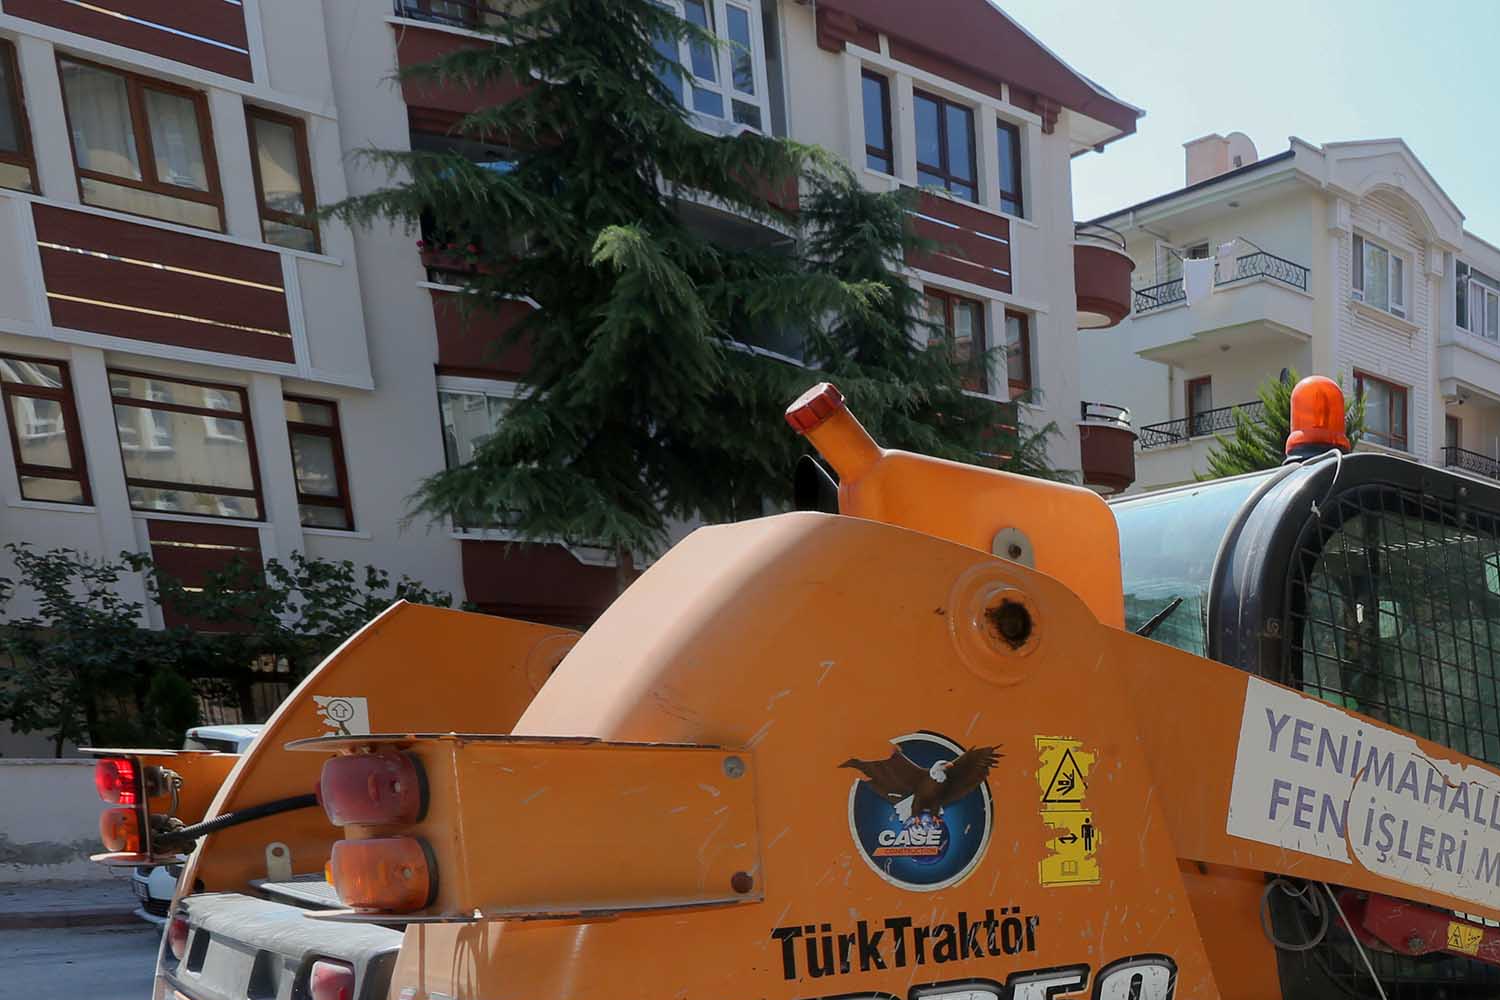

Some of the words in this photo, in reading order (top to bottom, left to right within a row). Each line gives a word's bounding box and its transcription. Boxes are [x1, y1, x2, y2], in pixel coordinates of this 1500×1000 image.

[878, 829, 942, 847] CASE
[1268, 778, 1350, 840] FEN
[1362, 796, 1469, 876] İŞLERİ
[771, 907, 1040, 980] TürkTraktör
